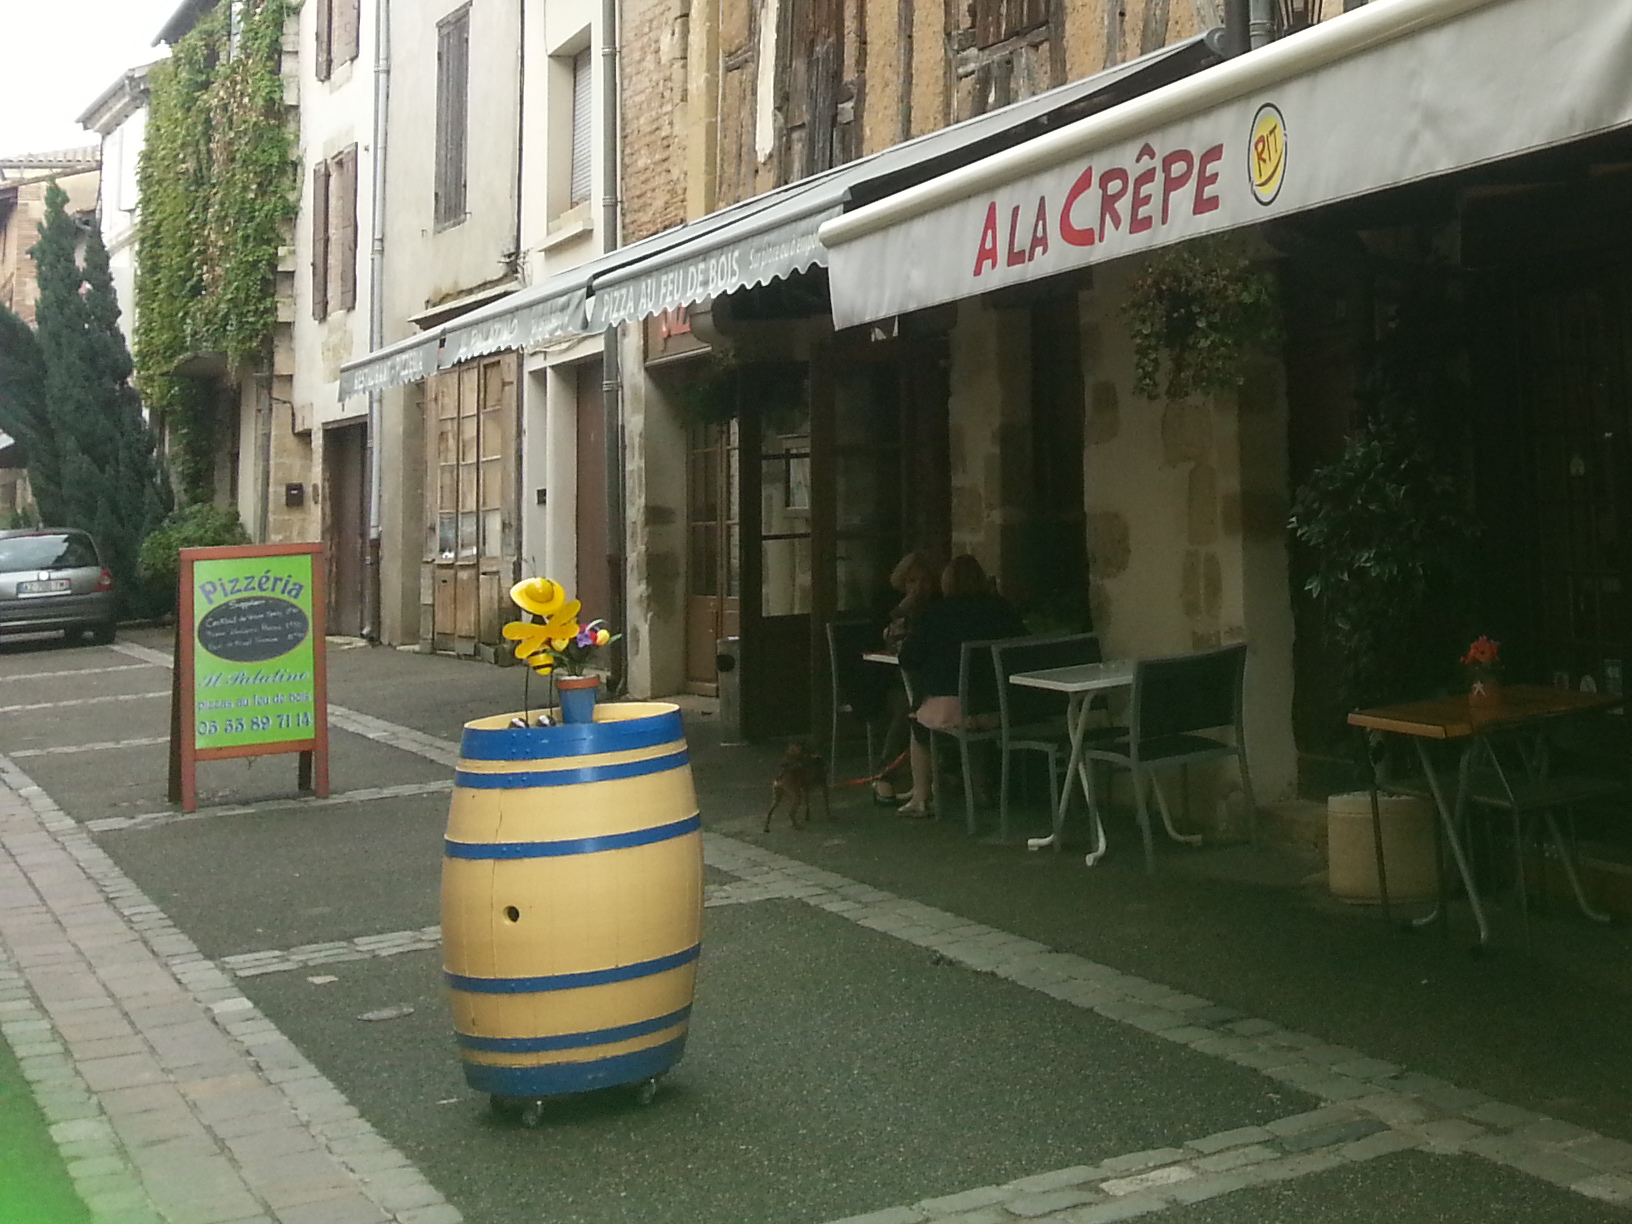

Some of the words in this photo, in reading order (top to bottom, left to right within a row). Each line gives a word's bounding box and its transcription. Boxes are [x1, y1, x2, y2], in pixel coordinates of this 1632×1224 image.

[1254, 123, 1279, 179] RIT
[973, 201, 998, 277] A
[1007, 195, 1049, 267] LA
[1059, 142, 1224, 247] CRÊPE
[601, 285, 636, 322] PIZZA
[638, 277, 657, 311] AU
[659, 268, 684, 306] FEU
[686, 261, 706, 297] DE
[708, 249, 740, 290] BOIS
[198, 569, 305, 605] Pizzéria
[198, 719, 220, 736] 05
[224, 717, 246, 734] 53
[250, 716, 272, 732] 89
[297, 711, 312, 727] 14
